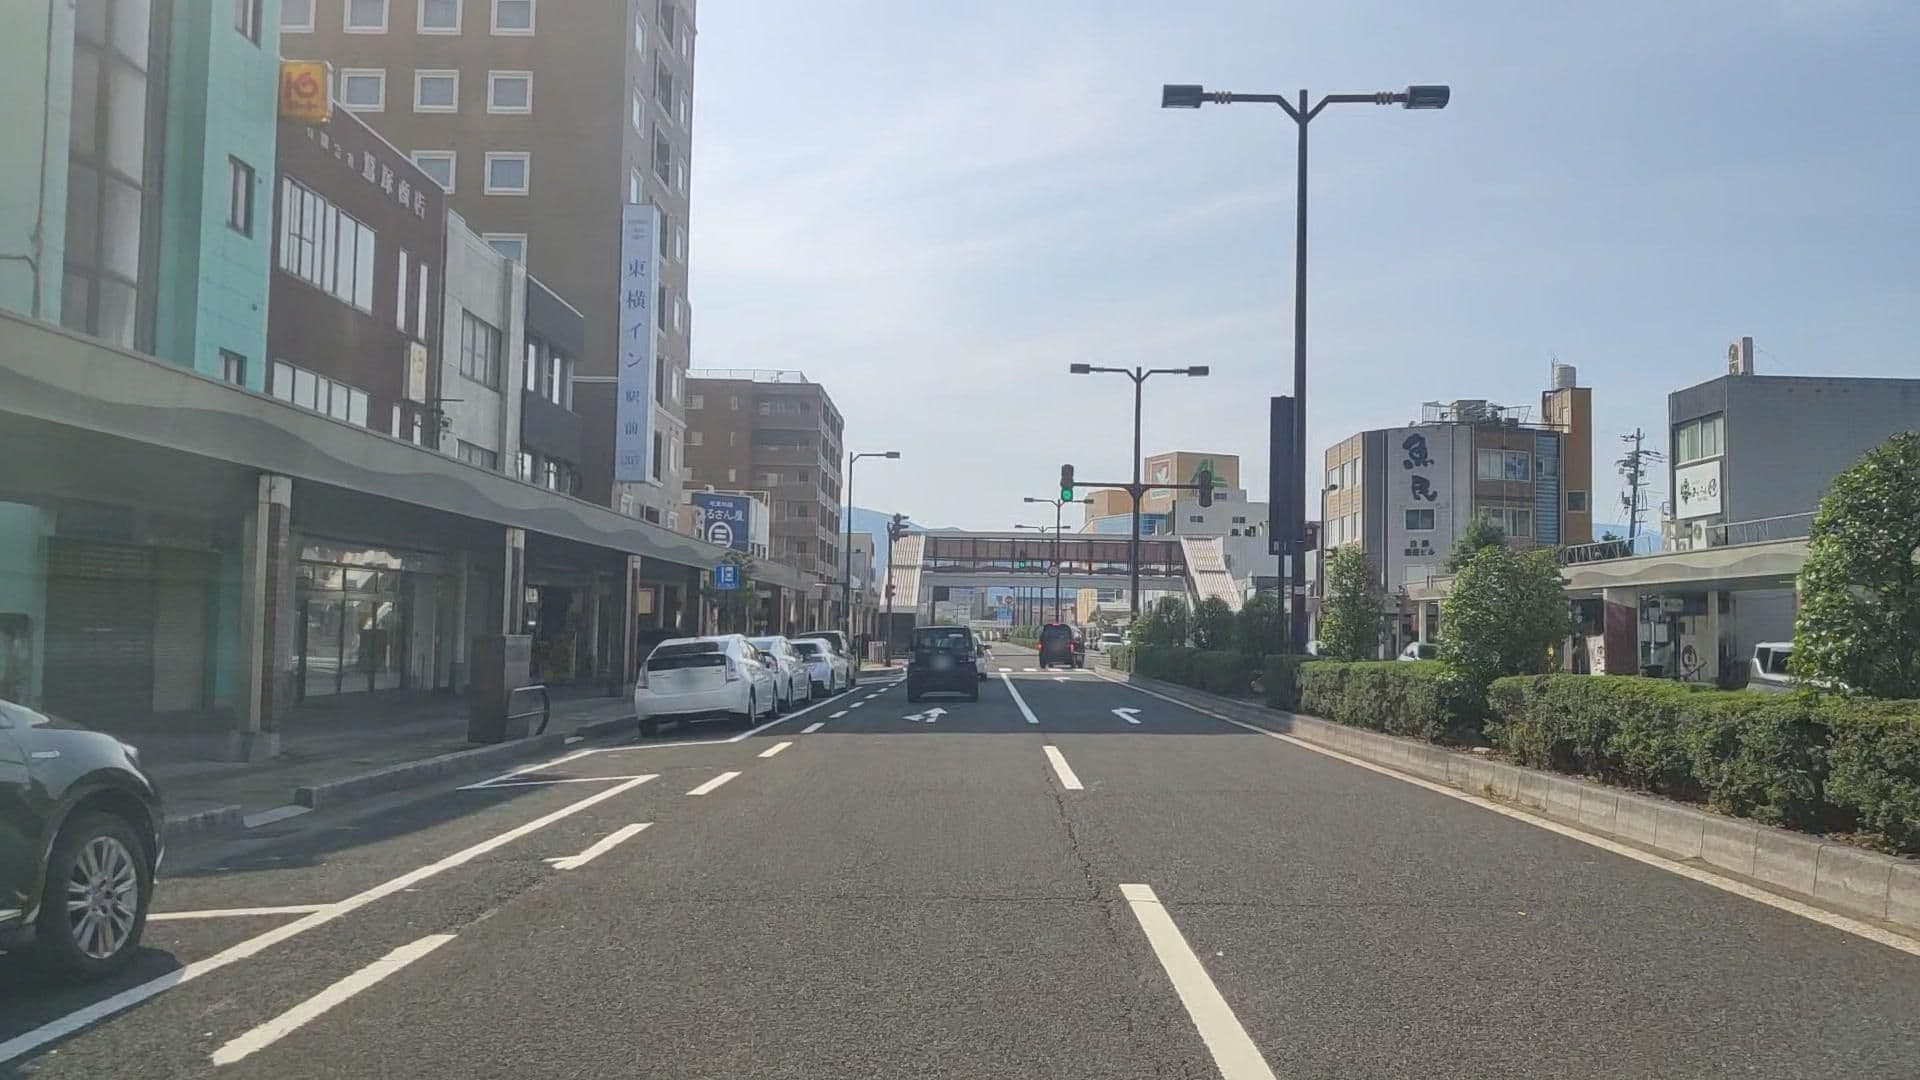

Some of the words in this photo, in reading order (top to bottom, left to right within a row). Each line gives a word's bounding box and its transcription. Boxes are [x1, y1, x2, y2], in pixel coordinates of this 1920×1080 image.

[1402, 433, 1439, 501] 魚民
[704, 509, 744, 521] るさん屋
